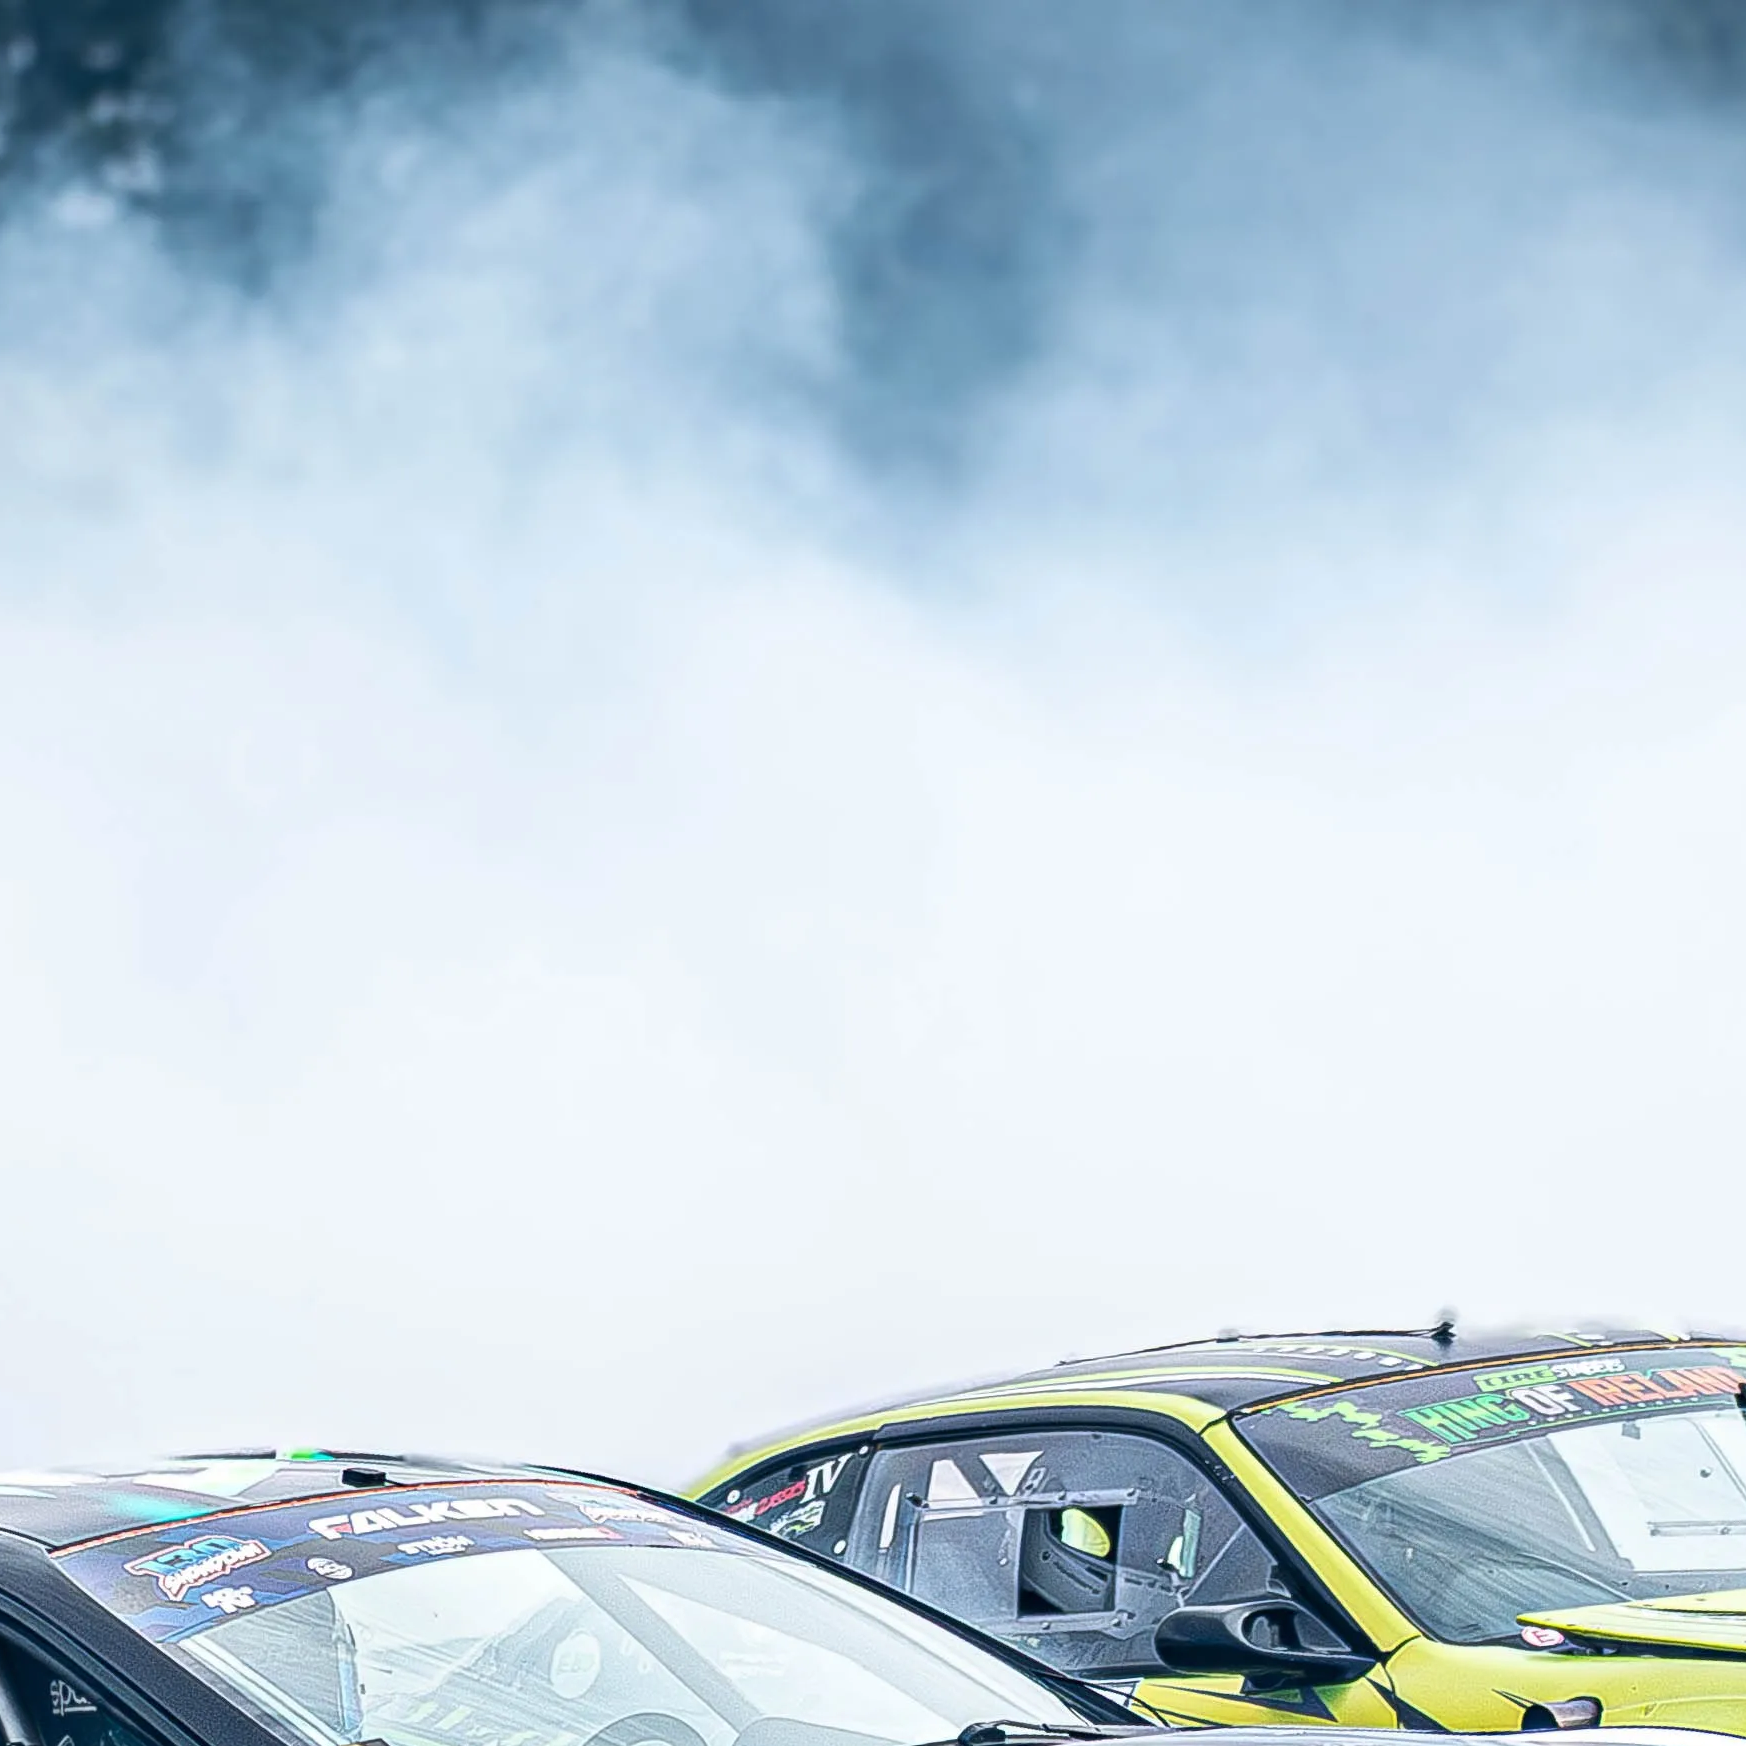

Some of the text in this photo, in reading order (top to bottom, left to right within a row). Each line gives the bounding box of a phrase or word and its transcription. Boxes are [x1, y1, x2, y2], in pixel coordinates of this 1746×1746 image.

[1403, 1394, 1531, 1444] KING
[1511, 1385, 1582, 1415] OF
[308, 1498, 545, 1541] FALKEN
